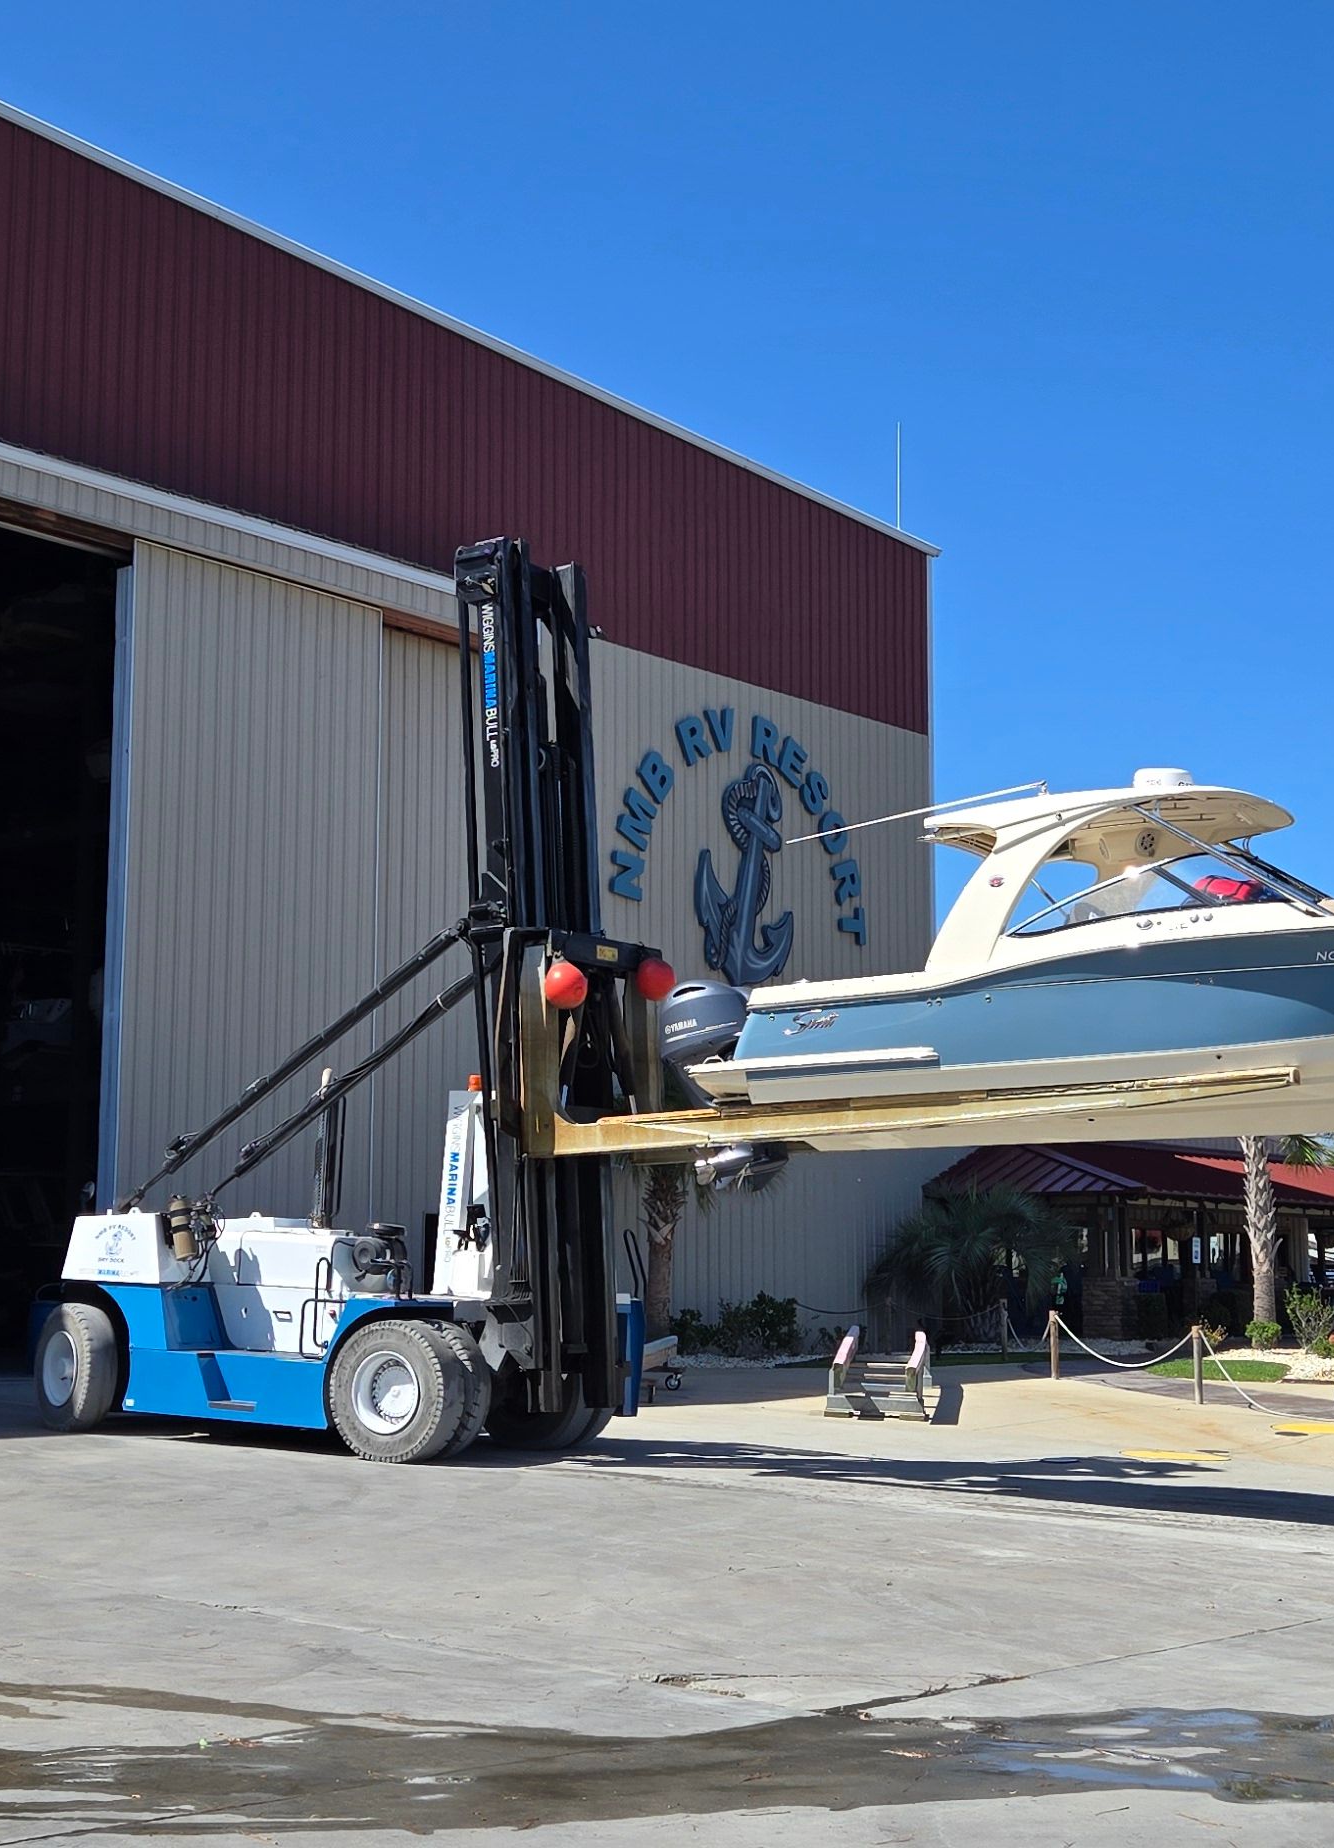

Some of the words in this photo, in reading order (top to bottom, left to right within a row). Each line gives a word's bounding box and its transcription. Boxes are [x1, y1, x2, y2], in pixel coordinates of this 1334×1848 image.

[610, 751, 675, 901] NMB
[676, 707, 735, 766] RV
[751, 715, 865, 946] RESORT
